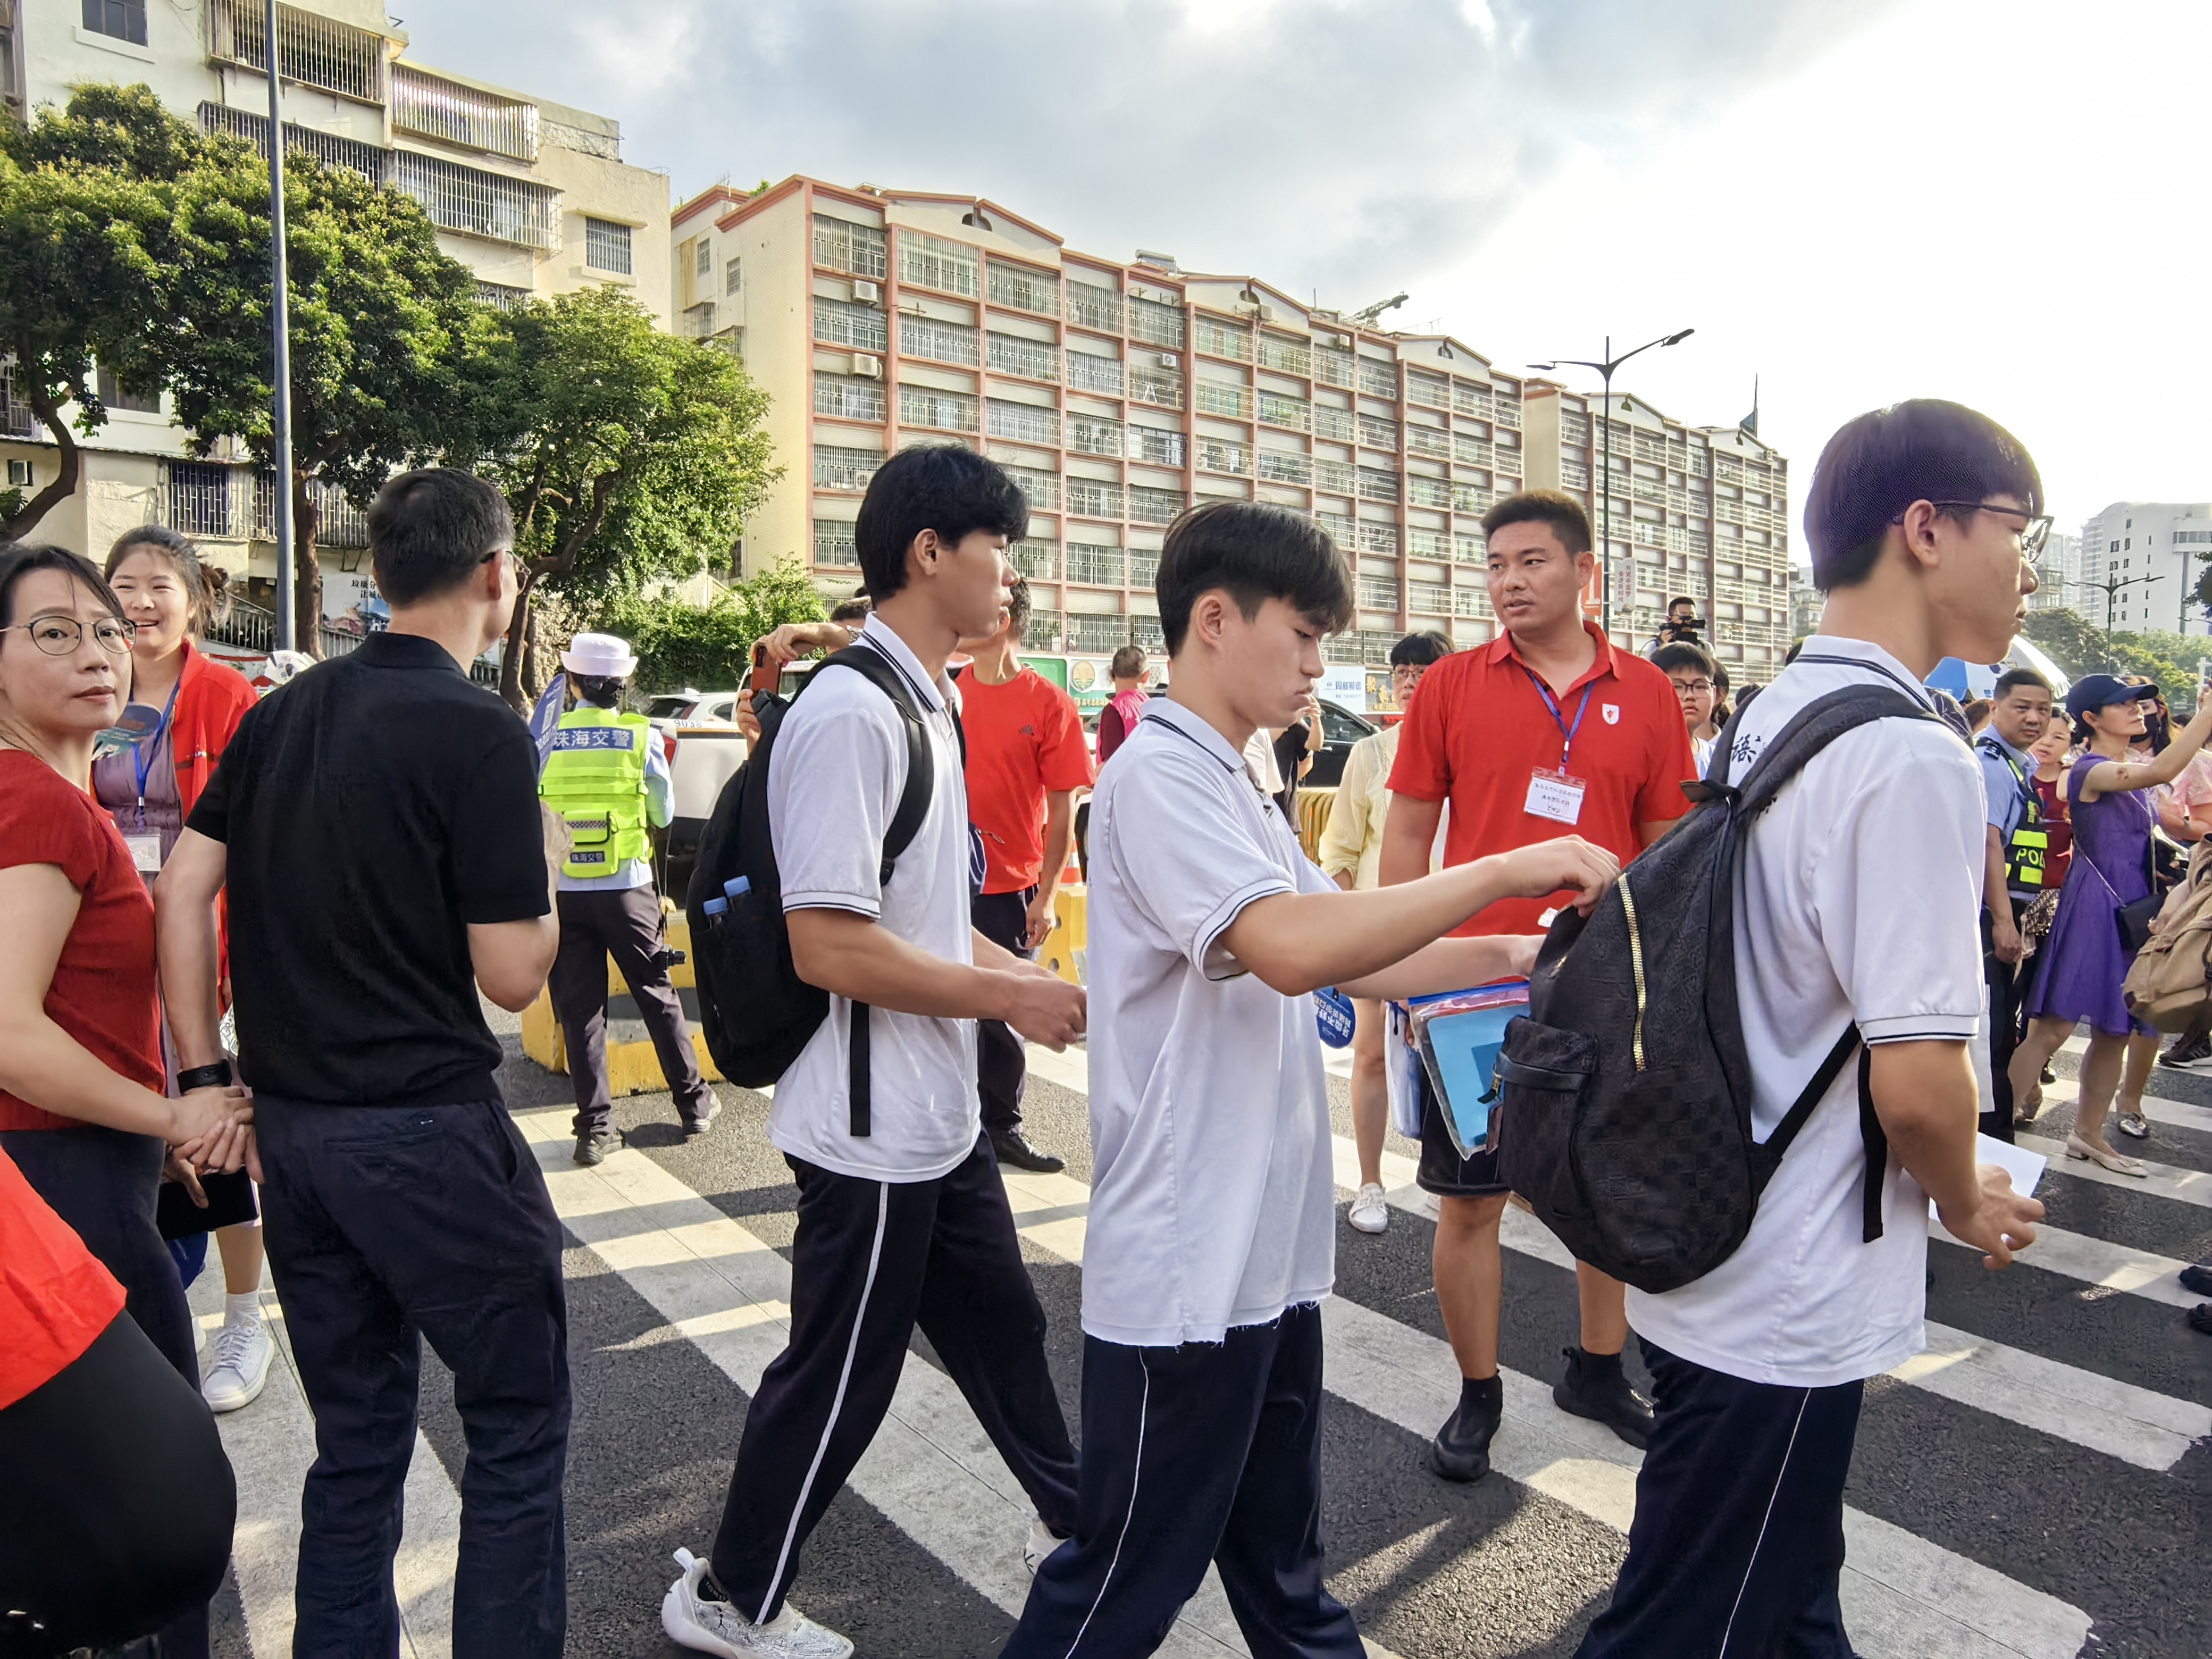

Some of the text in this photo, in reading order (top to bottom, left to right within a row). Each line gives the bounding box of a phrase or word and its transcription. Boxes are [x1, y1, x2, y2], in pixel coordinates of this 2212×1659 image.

[674, 719, 702, 728] 9038
[555, 729, 630, 747] 珠海交警
